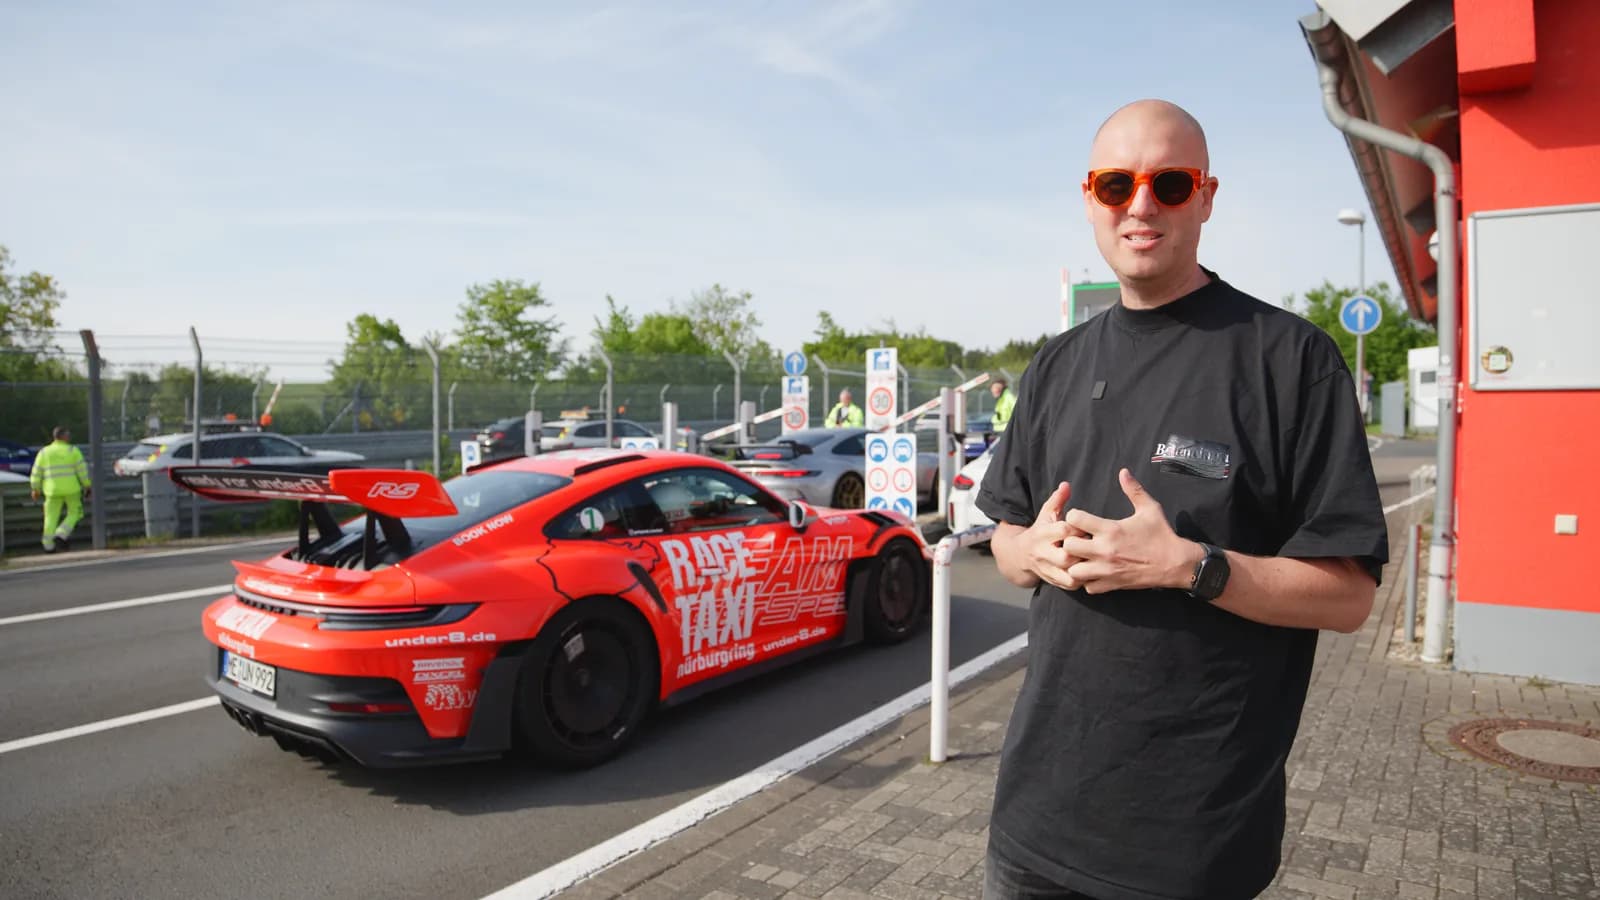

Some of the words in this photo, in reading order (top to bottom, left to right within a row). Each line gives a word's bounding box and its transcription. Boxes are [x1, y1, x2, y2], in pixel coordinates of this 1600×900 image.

[367, 482, 421, 498] RS
[453, 528, 488, 547] BOOK
[487, 514, 514, 533] NOW
[584, 508, 600, 532] 1
[660, 531, 756, 590] RACE
[675, 582, 757, 657] TAXI
[384, 631, 497, 648] under8.de
[677, 642, 756, 679] nürburgring
[255, 666, 273, 692] 992
